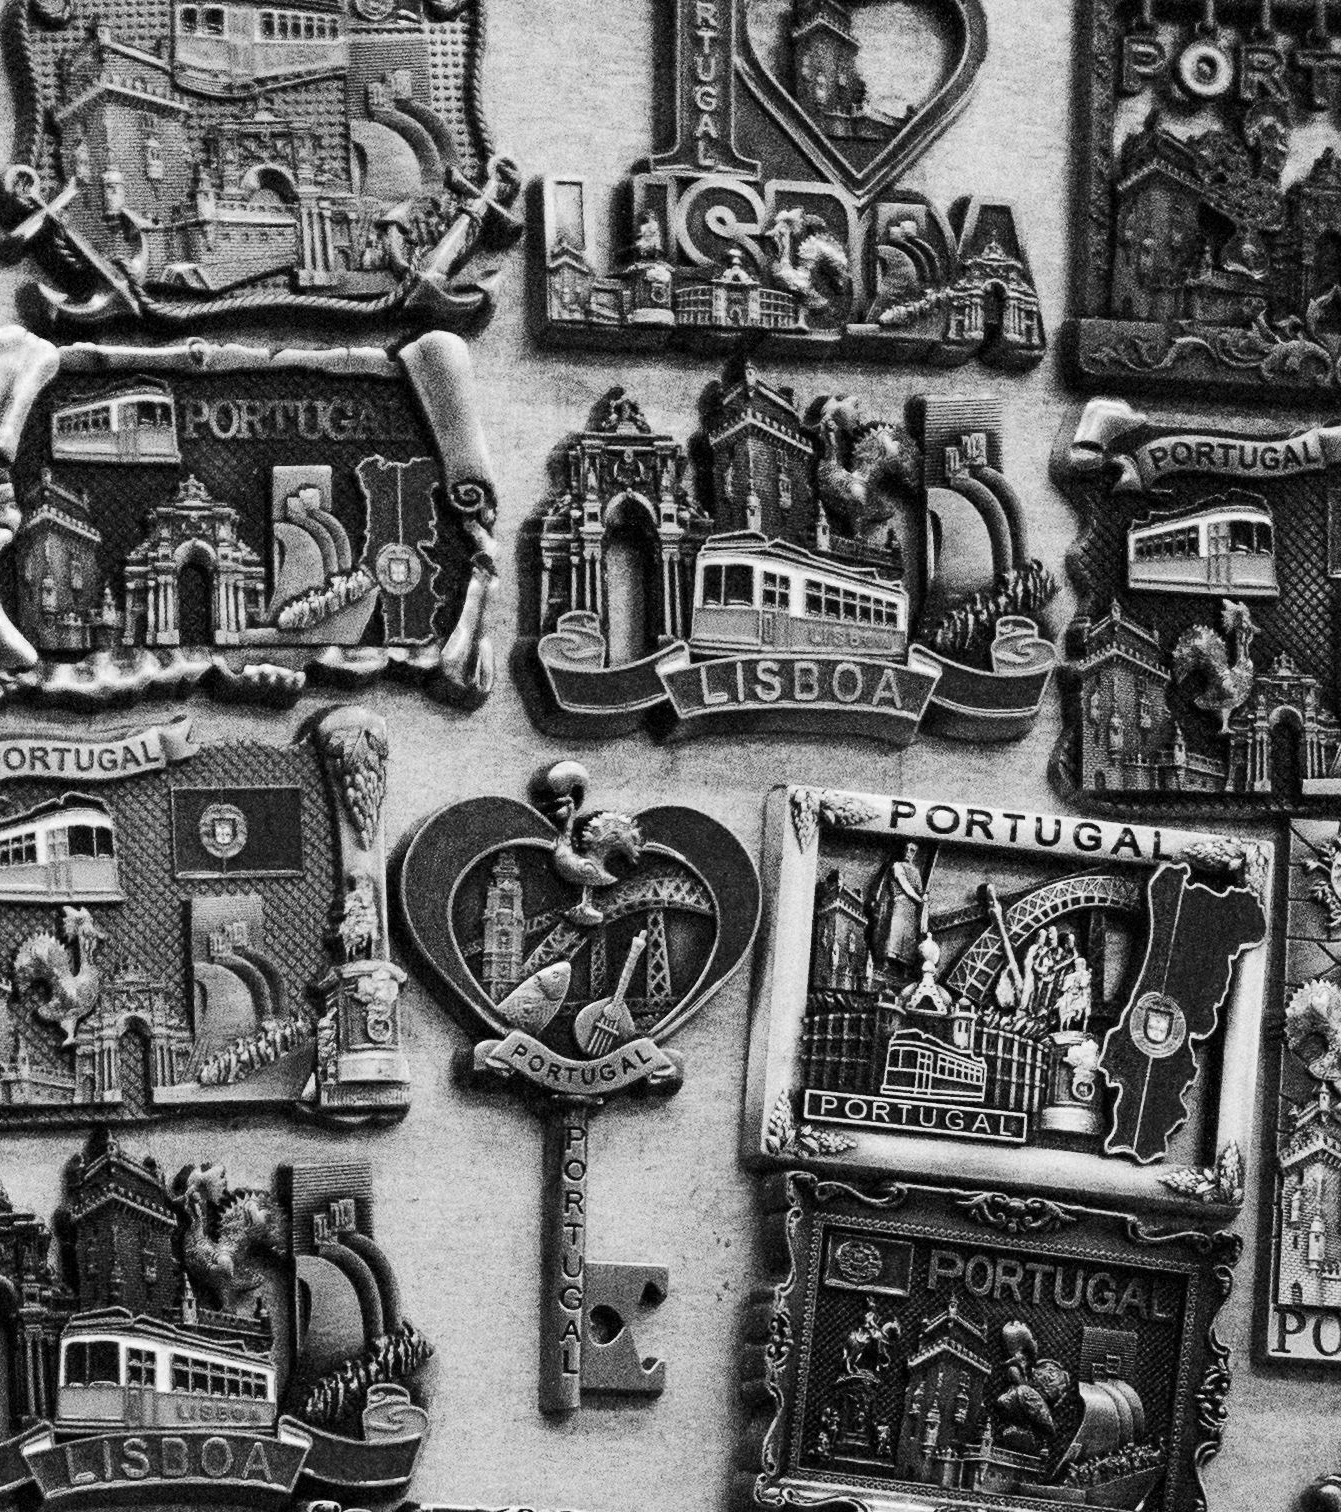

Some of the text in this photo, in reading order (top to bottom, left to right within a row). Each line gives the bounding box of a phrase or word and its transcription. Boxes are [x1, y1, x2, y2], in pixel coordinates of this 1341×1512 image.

[1149, 431, 1316, 473] PORTUGAL
[700, 662, 903, 712] LISBOA
[889, 800, 1173, 861] PORTUGAL
[510, 1042, 652, 1086] PORTUGAL
[819, 1094, 1014, 1138] PORTUGAL
[560, 1125, 586, 1376] PORTUGAL
[926, 1248, 1174, 1321] PORTUGAL
[67, 1438, 272, 1481] LISBOA
